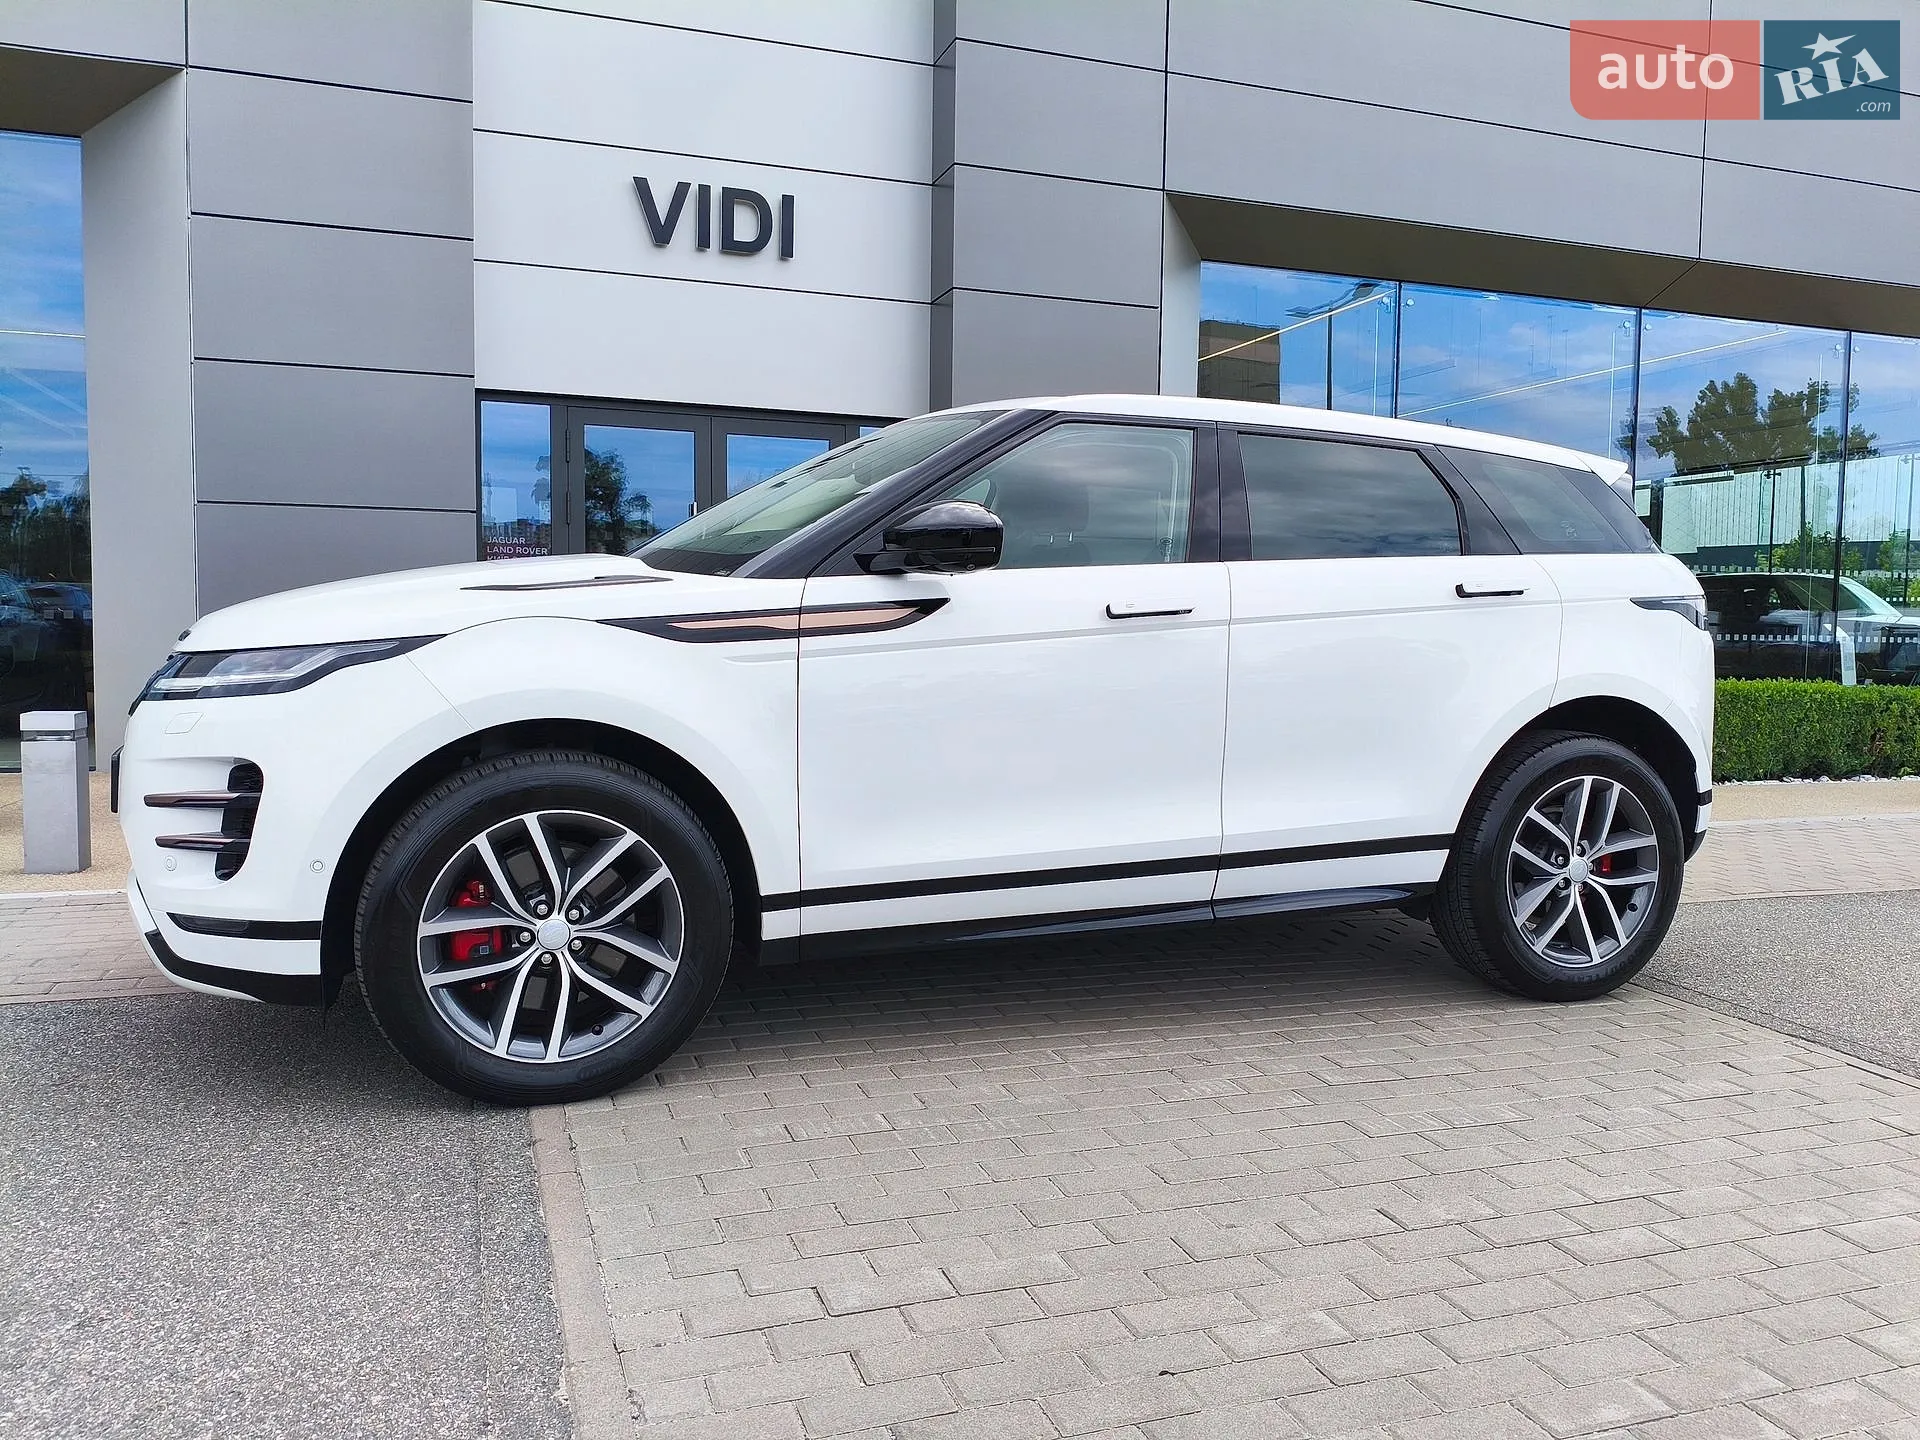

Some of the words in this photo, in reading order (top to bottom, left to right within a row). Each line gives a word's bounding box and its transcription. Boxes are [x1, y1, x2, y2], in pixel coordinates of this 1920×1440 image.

[632, 176, 796, 260] VIDI
[487, 536, 526, 544] JAGUAR
[487, 546, 514, 554] LAND
[515, 546, 548, 555] ROVER
